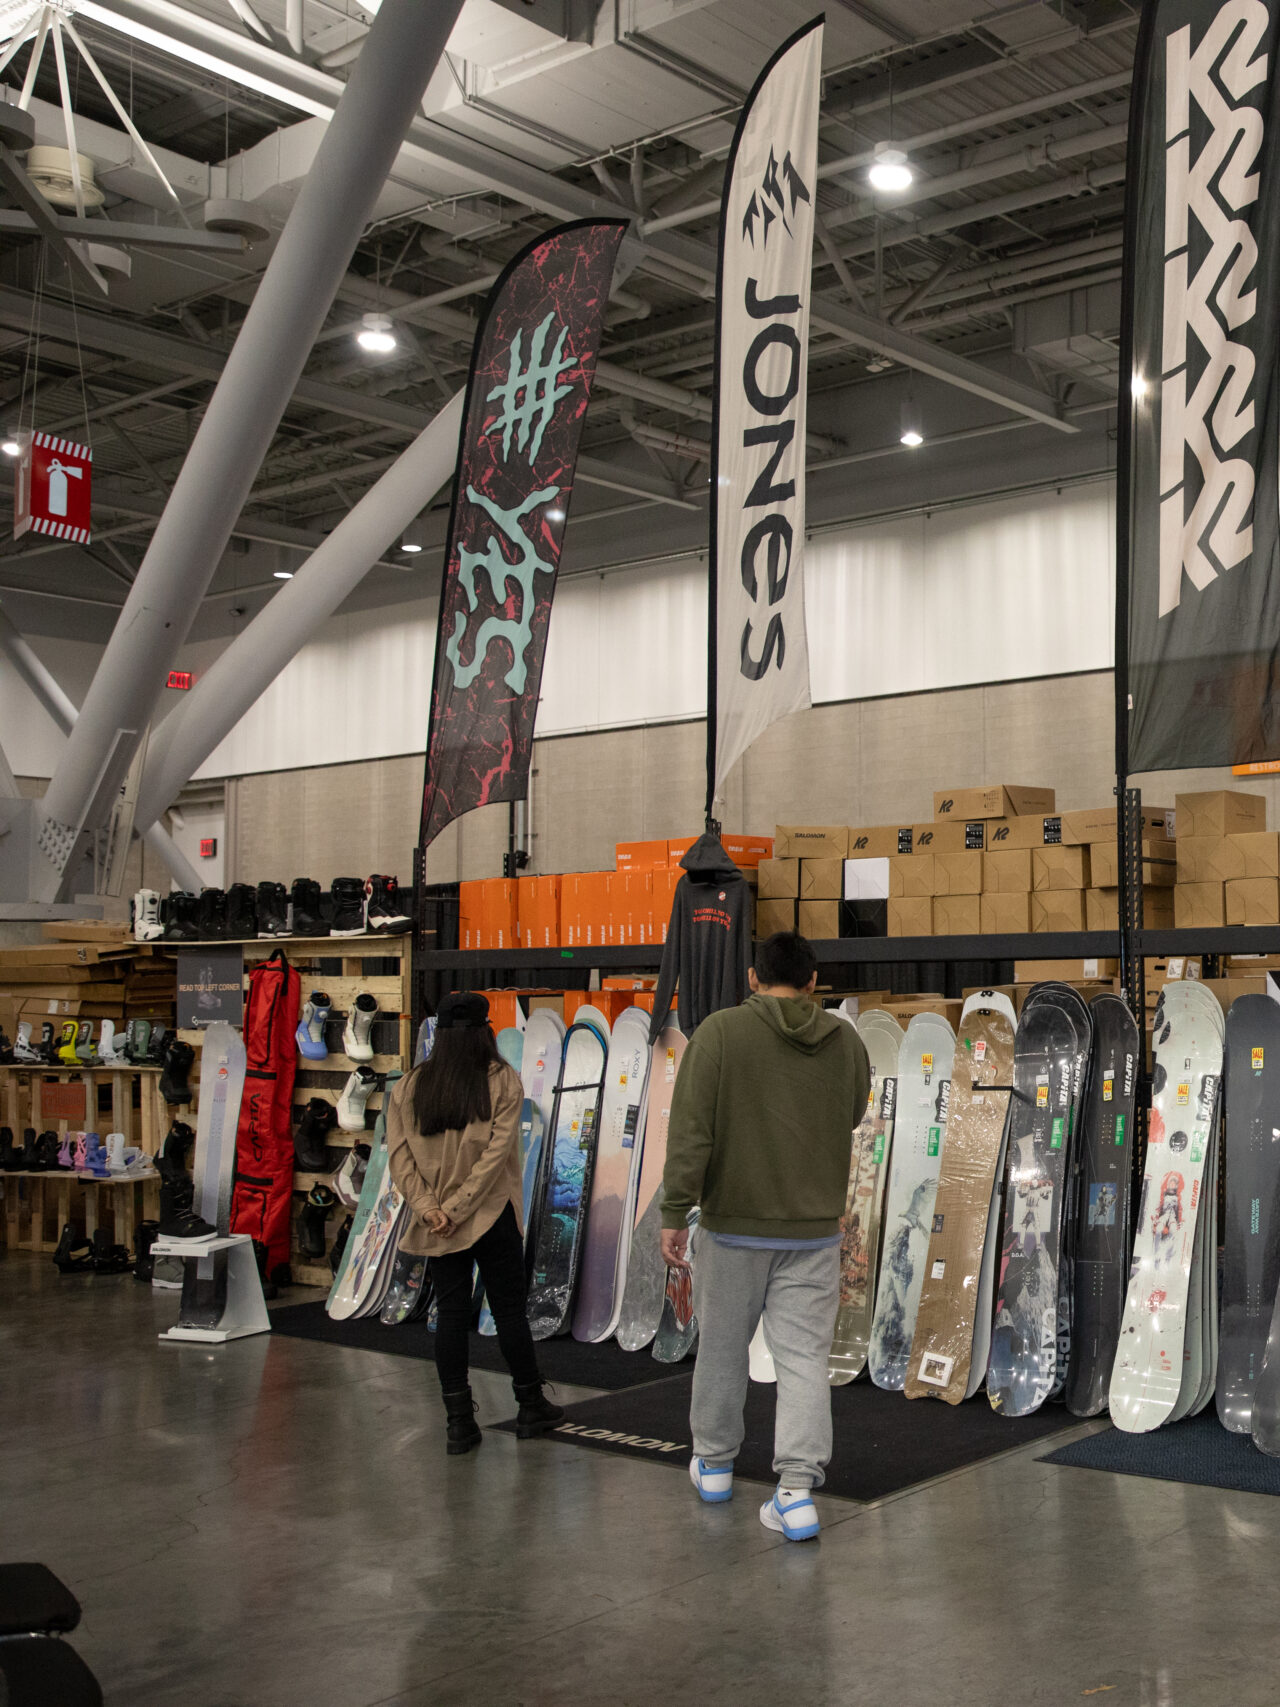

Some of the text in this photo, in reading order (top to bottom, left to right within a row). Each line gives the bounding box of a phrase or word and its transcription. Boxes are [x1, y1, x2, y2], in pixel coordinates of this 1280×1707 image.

[446, 485, 559, 695] YES
[168, 671, 190, 689] EXIT
[938, 800, 953, 813] K2
[917, 832, 934, 845] K2
[992, 827, 1010, 841] K2
[853, 836, 869, 850] K2
[922, 1054, 932, 1064] SALE
[1252, 1048, 1263, 1058] SALE
[632, 1048, 640, 1079] ROXY
[1177, 1084, 1188, 1094] SALE
[1031, 1308, 1056, 1407] CAPiTA
